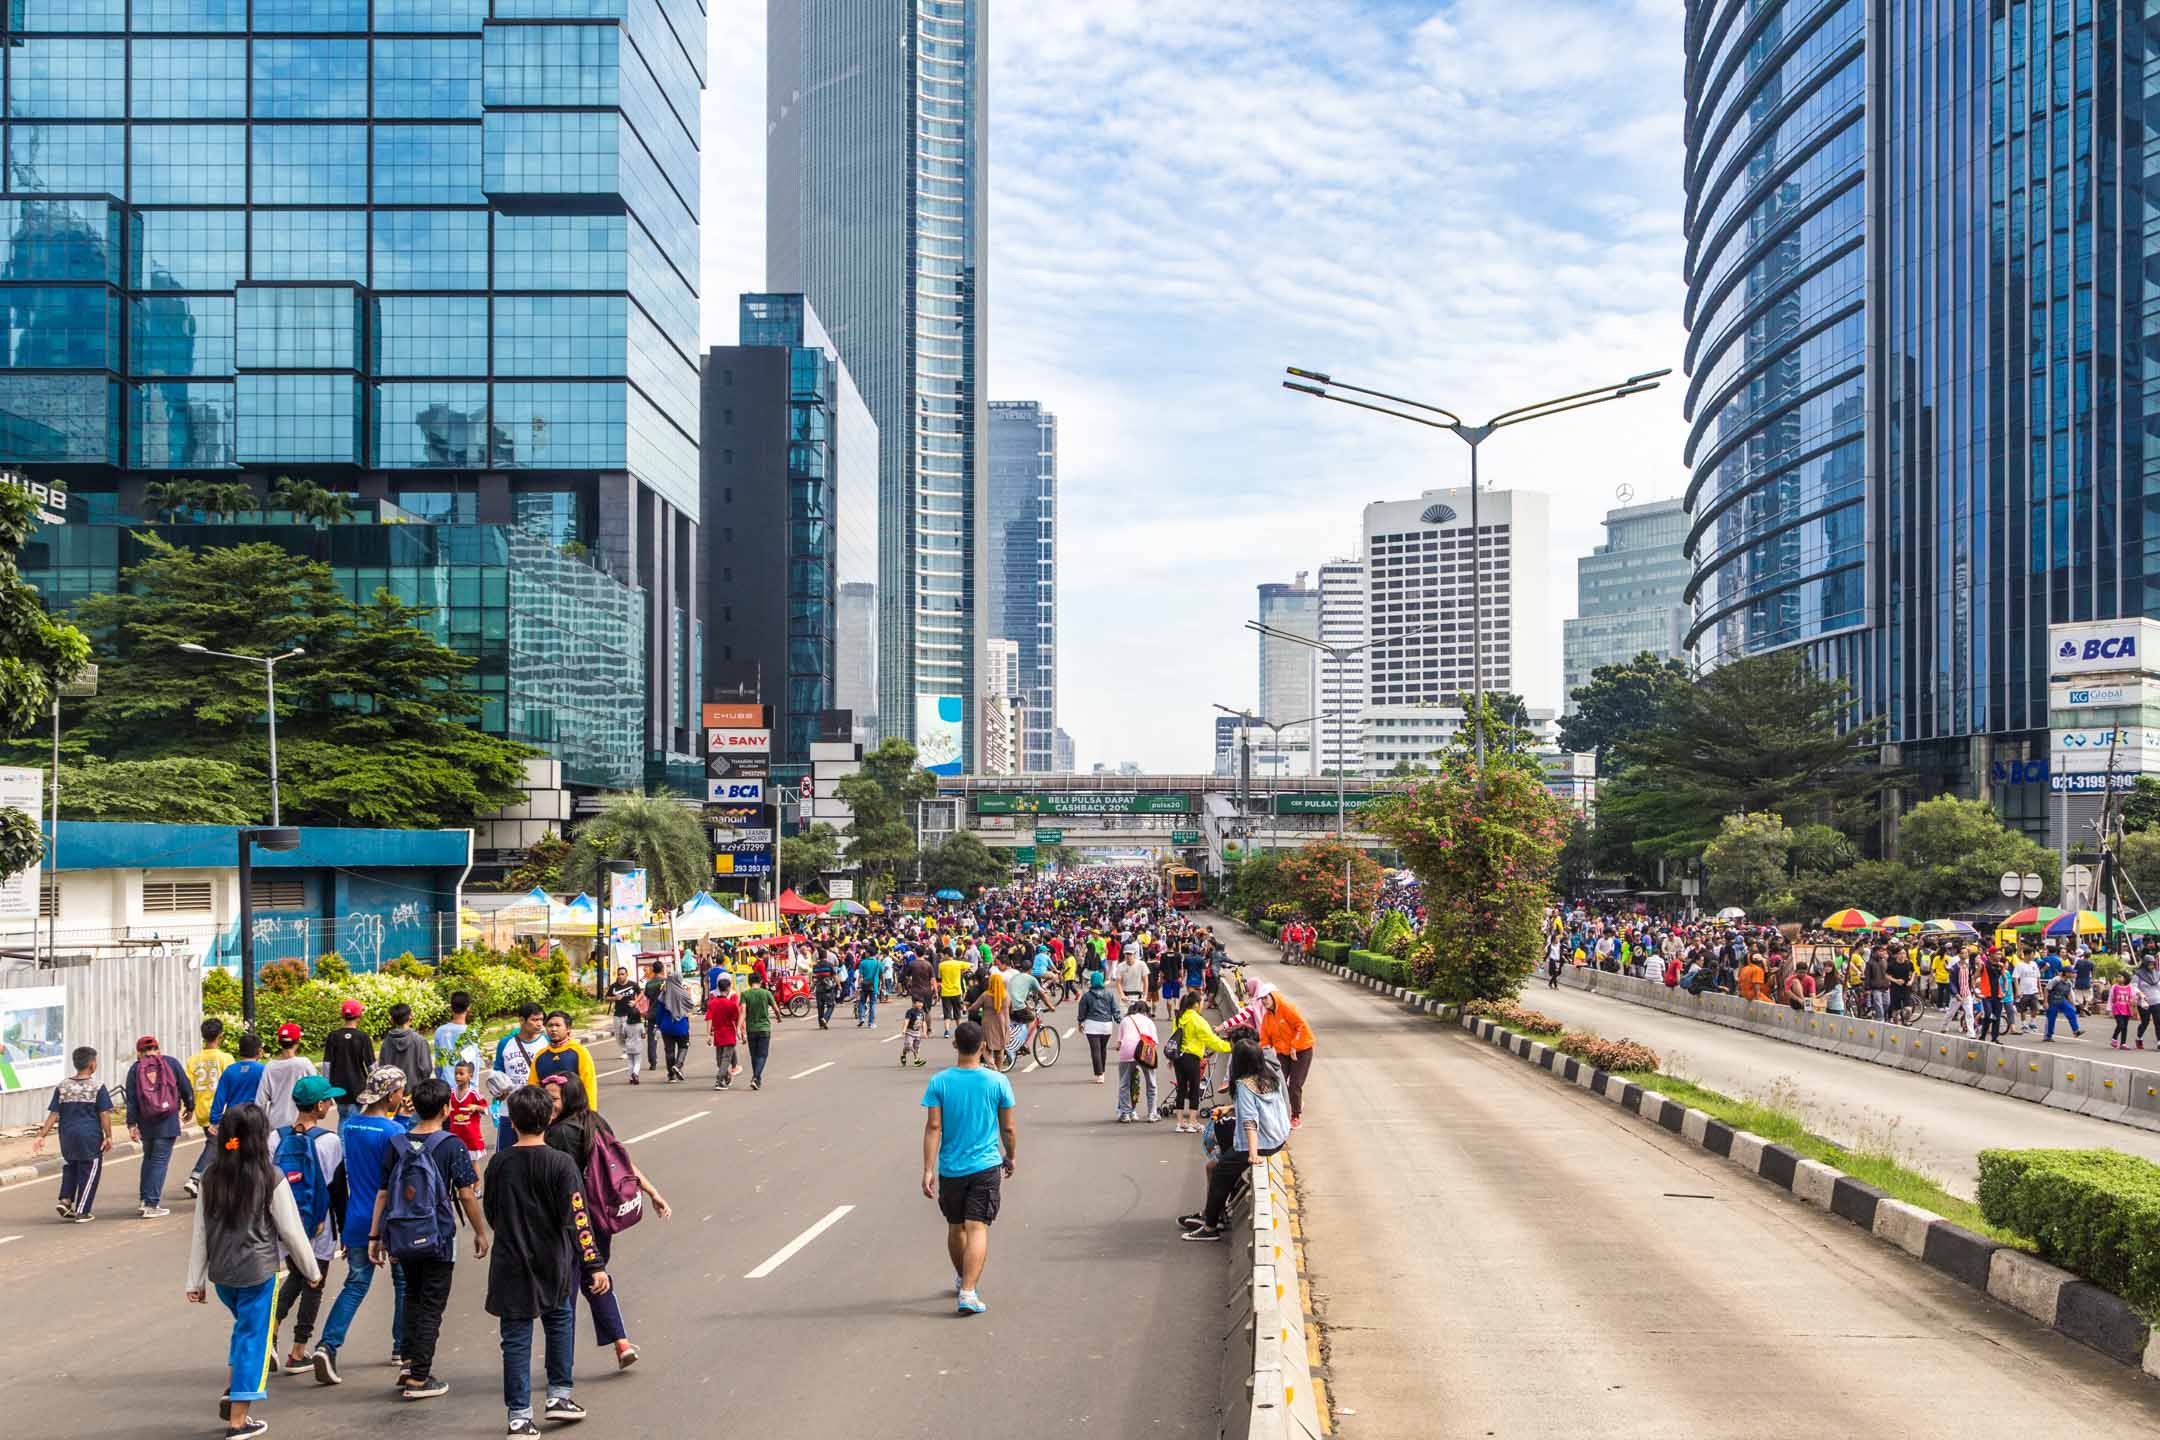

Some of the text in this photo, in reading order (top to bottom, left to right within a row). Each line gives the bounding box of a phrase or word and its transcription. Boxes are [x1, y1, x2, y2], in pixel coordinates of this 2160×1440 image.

[2082, 636, 2135, 660] BCA
[2071, 692, 2089, 703] KG
[729, 737, 768, 745] SANY
[728, 785, 759, 798] BCA
[1055, 804, 1129, 812] CASHBACK 20%
[1152, 801, 1181, 809] pulsa20
[735, 864, 747, 872] 293
[749, 864, 761, 872] 293
